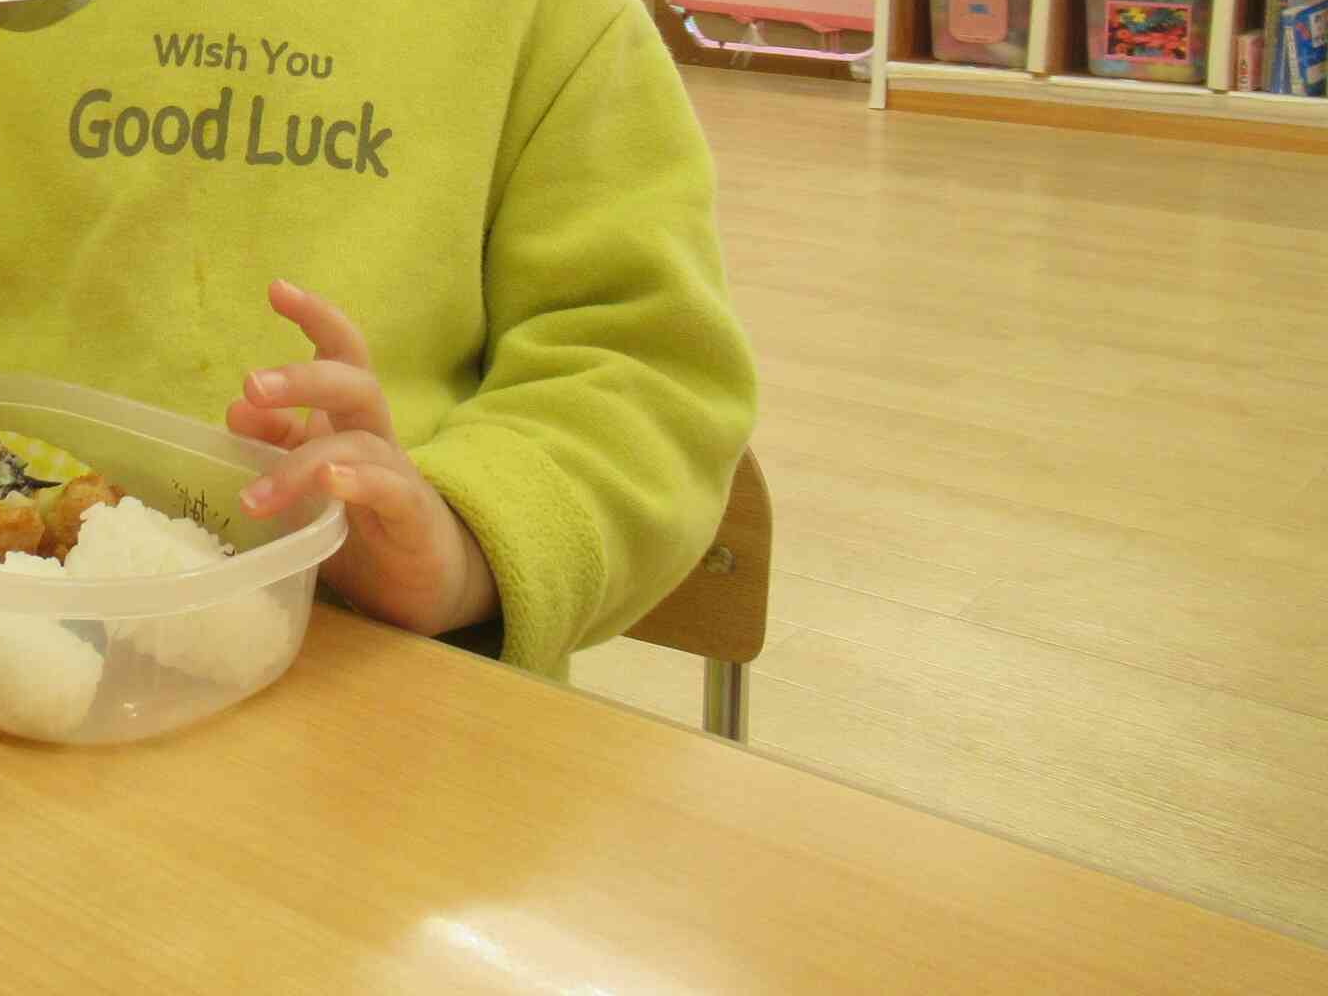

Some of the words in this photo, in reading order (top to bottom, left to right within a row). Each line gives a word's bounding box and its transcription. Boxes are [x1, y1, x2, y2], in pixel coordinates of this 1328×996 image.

[153, 32, 248, 71] Wish
[260, 37, 334, 79] You
[69, 86, 233, 161] Good
[245, 94, 393, 178] Luck
